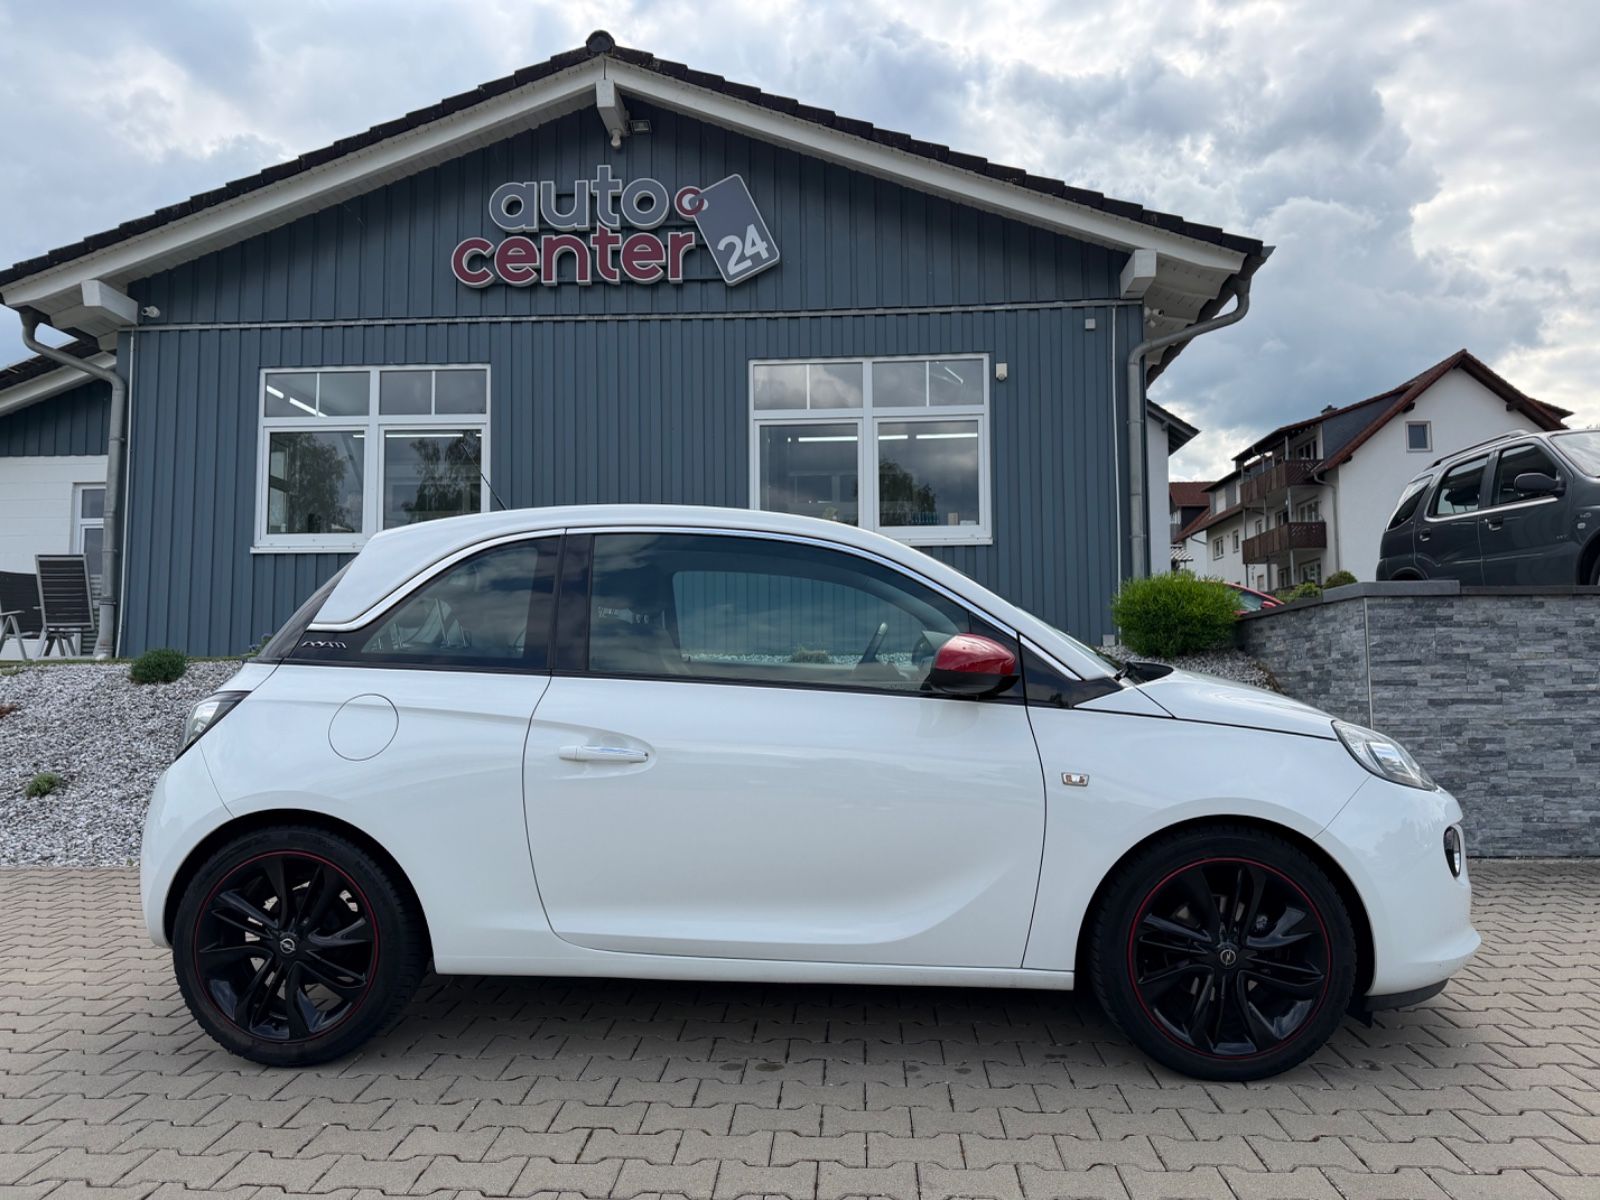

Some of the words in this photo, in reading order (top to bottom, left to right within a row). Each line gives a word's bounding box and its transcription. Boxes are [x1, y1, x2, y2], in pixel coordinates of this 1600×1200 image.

[489, 164, 670, 233] auto
[450, 220, 696, 288] center
[716, 223, 769, 276] 24
